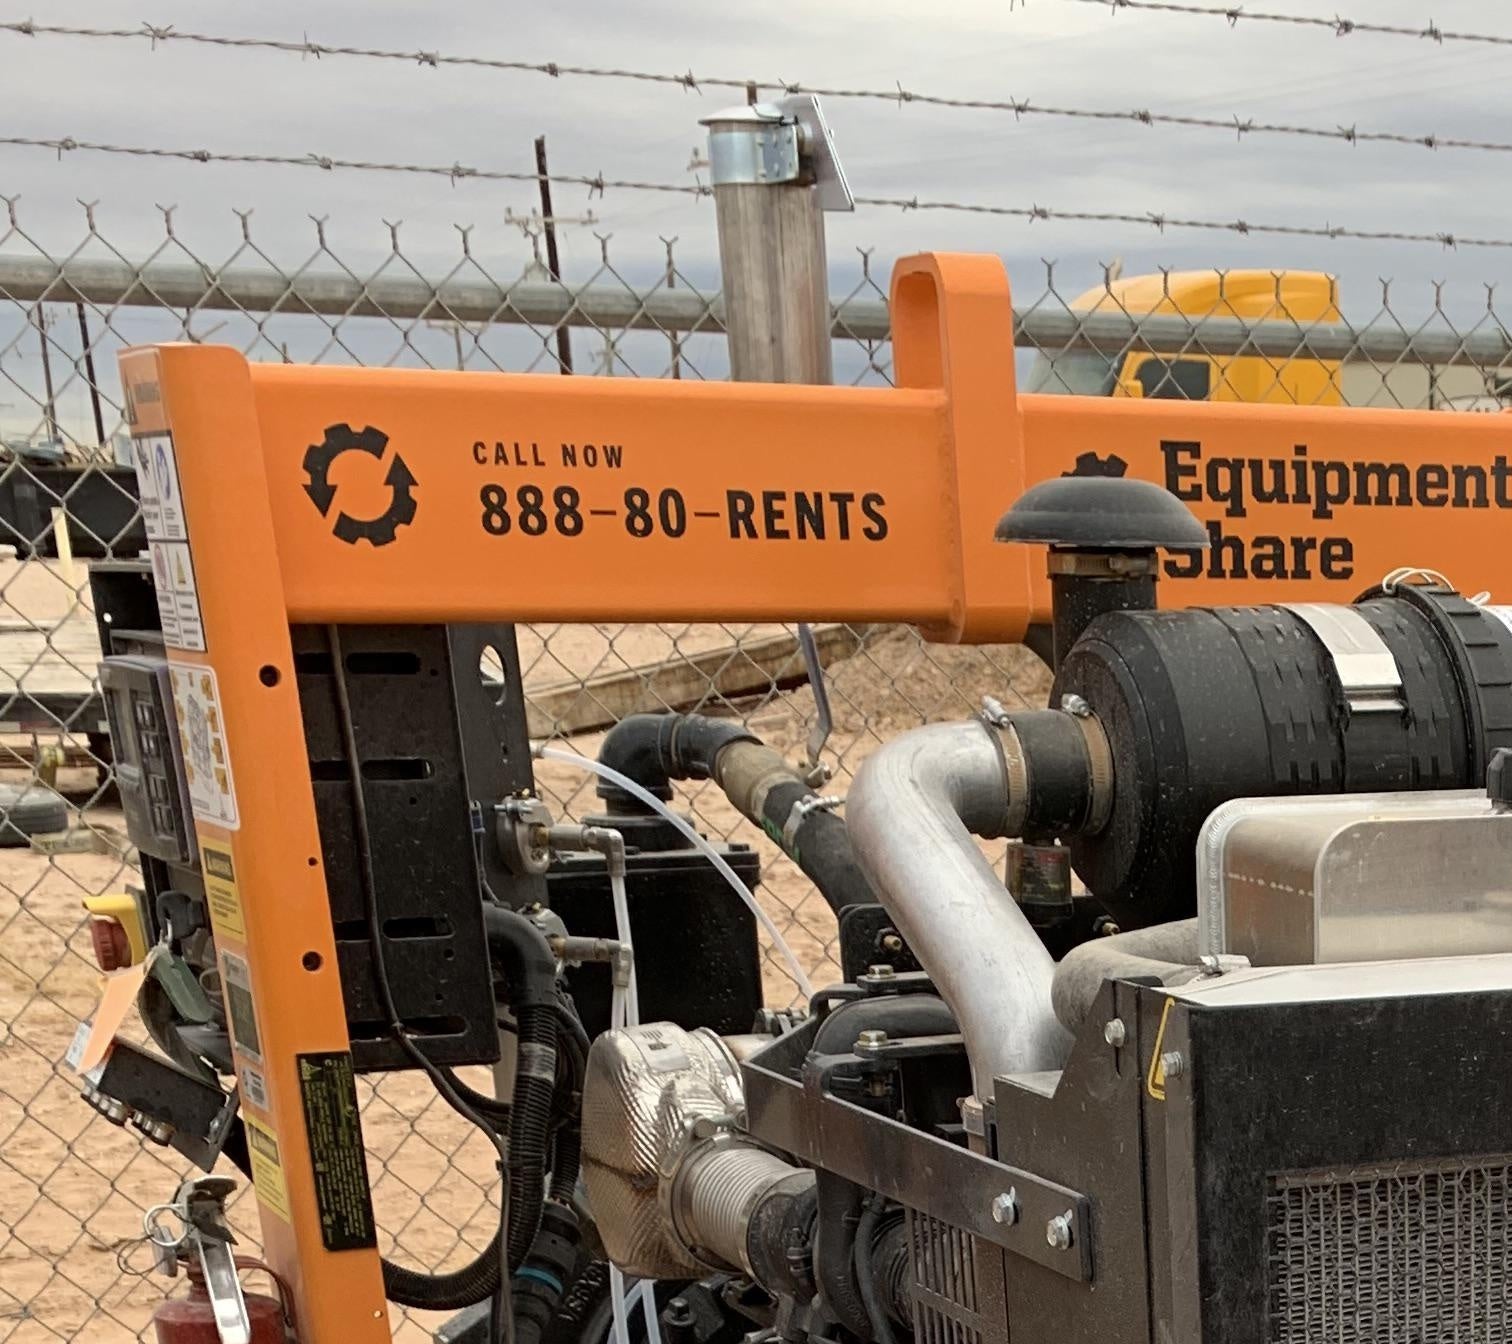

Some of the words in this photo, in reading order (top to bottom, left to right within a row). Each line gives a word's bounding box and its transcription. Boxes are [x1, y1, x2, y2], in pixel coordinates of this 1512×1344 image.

[472, 441, 546, 467] CALL
[561, 444, 623, 469] NOW
[479, 483, 889, 541] 888-80-RENTS
